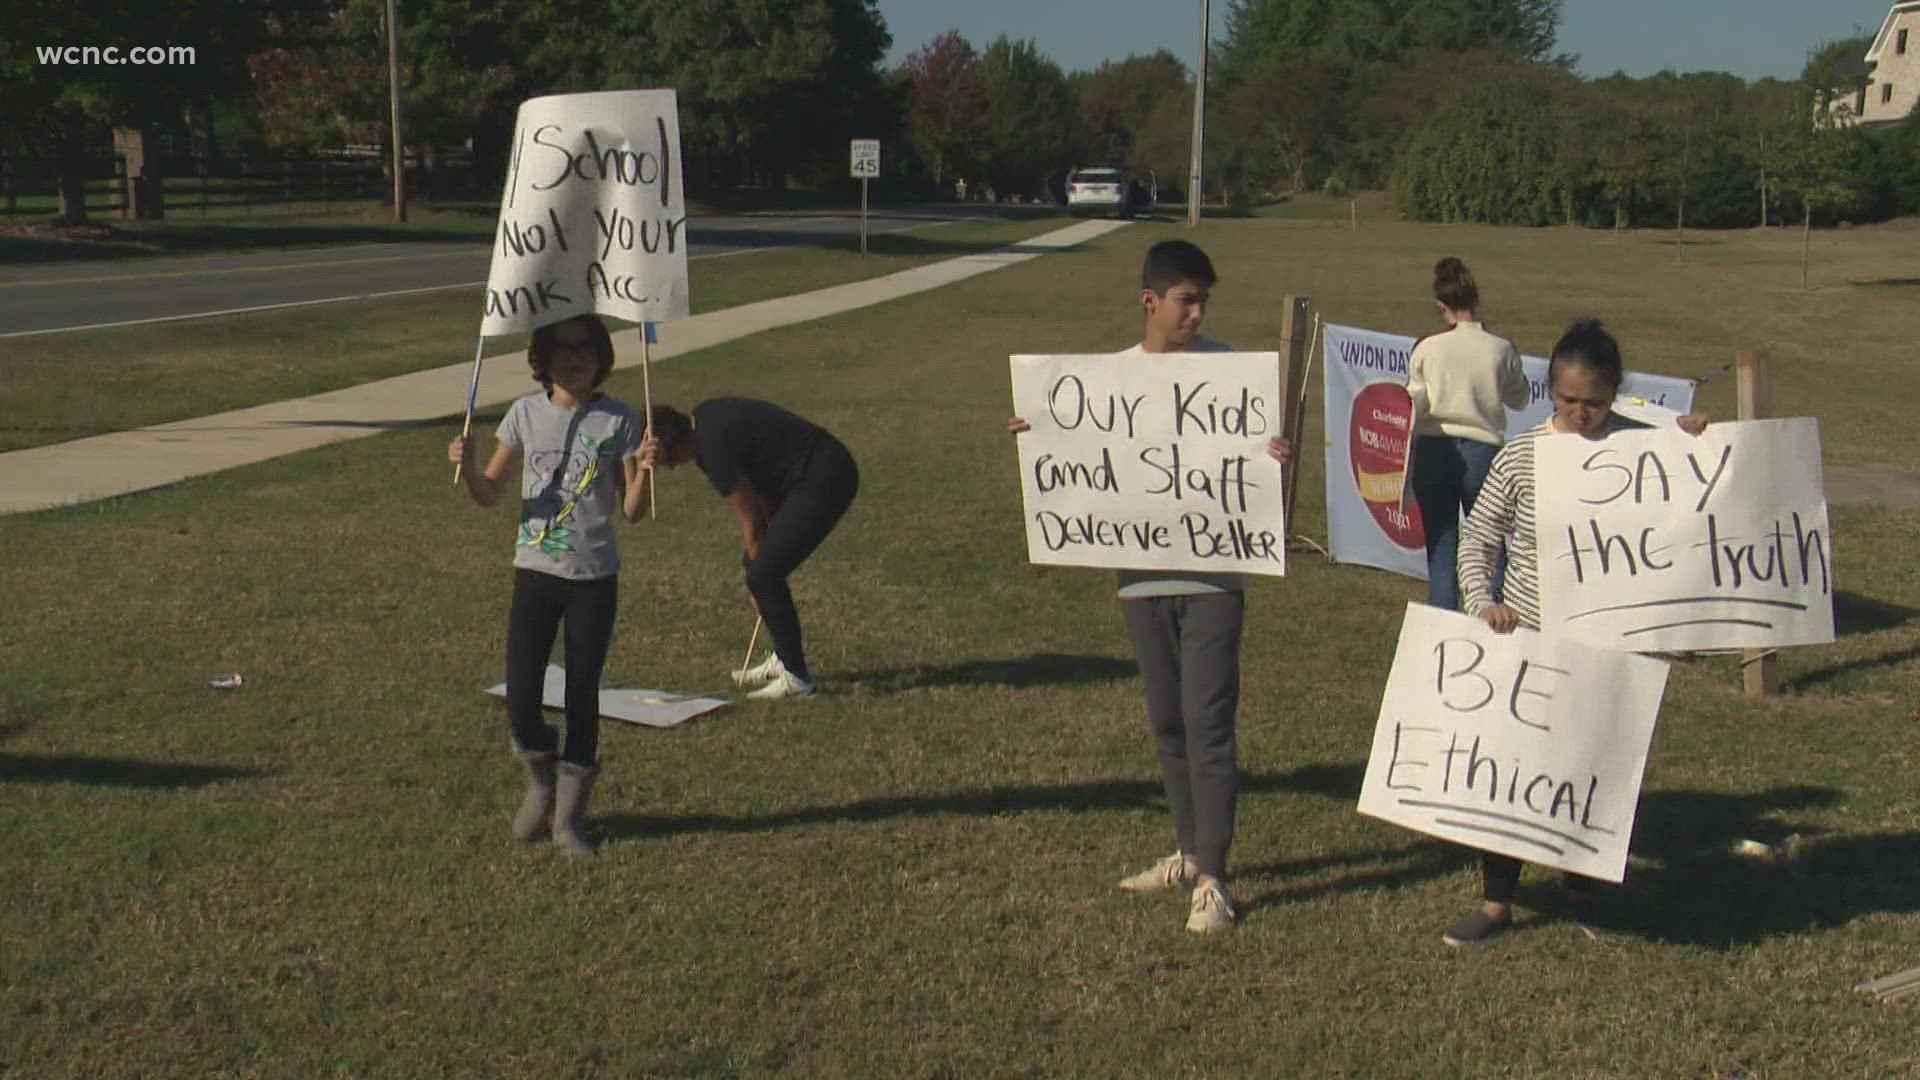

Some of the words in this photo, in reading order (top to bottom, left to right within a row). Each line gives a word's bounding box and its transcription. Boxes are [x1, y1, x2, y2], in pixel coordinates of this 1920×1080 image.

[532, 117, 669, 207] School
[854, 160, 877, 173] 45
[485, 282, 572, 318] ank
[1341, 341, 1384, 371] UNION
[1048, 375, 1147, 439] Our
[1174, 381, 1267, 437] Kids
[1035, 447, 1119, 496] and
[1140, 443, 1260, 514] Staff
[1578, 444, 1732, 512] SAY
[1690, 511, 1831, 595] truth
[1434, 637, 1571, 732] BE
